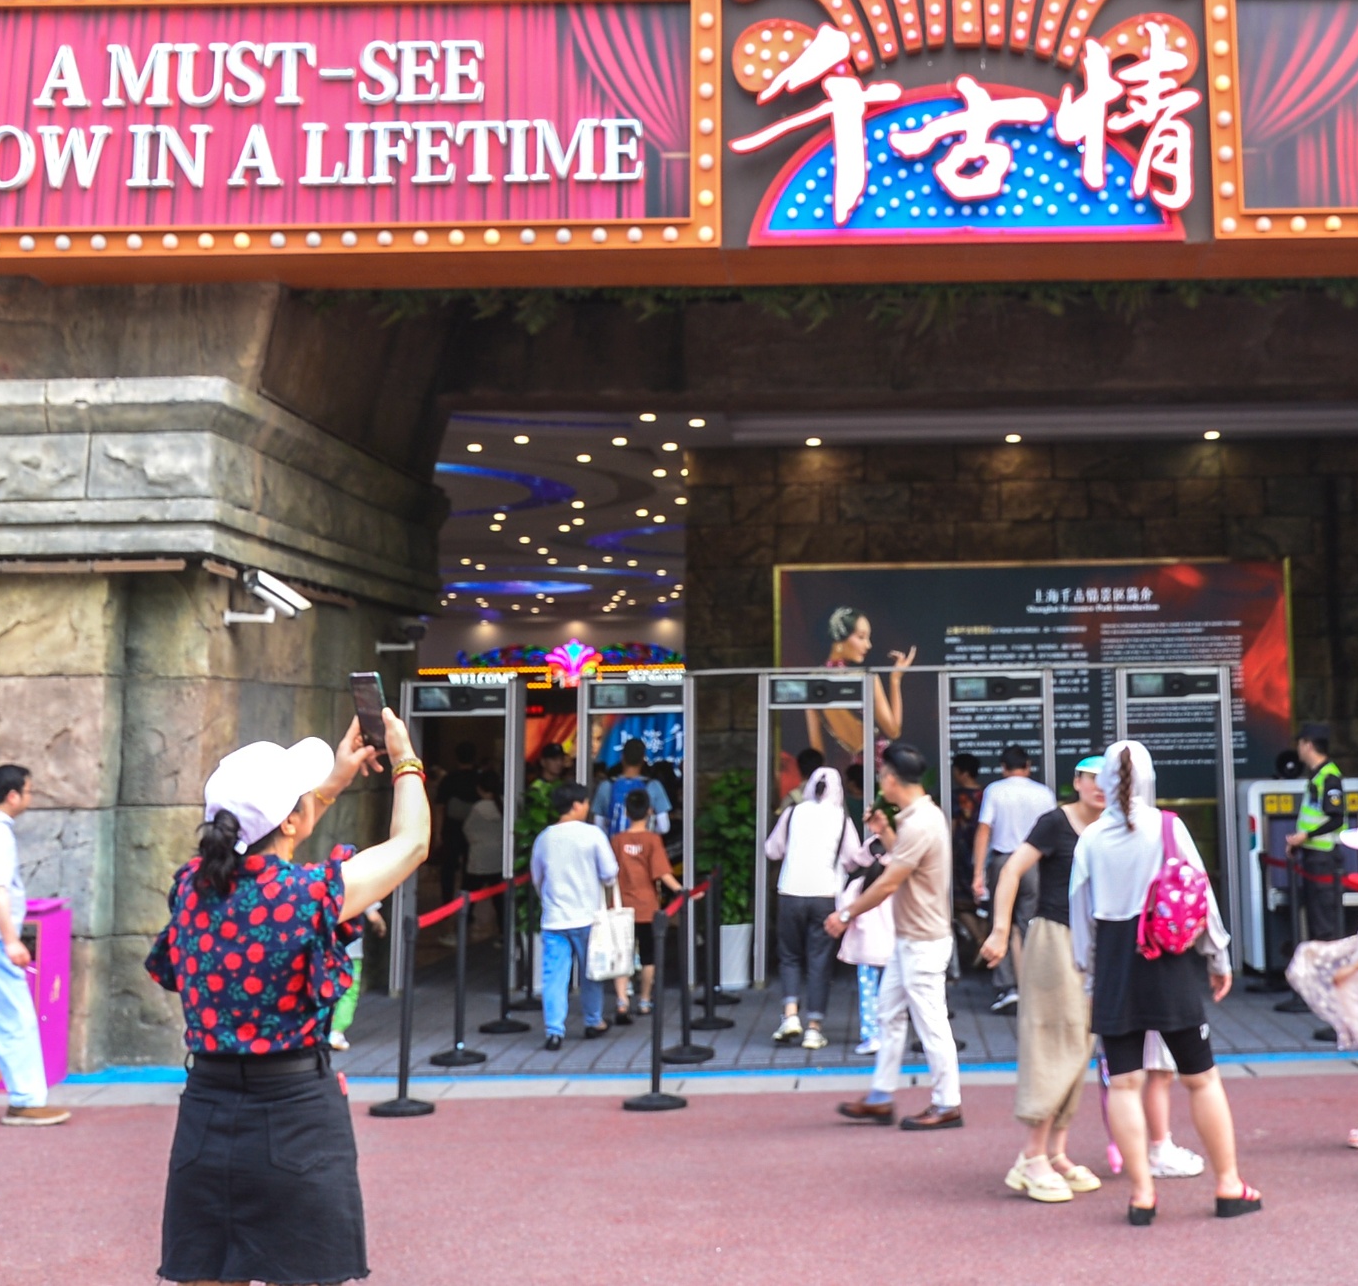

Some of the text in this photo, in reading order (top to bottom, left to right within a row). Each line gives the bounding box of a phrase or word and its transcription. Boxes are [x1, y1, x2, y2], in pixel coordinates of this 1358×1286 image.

[34, 40, 485, 107] A MUST-SEE
[126, 123, 211, 189] IN
[228, 122, 284, 186] A
[299, 118, 644, 185] LIFETIME
[730, 22, 1202, 226] 千古情
